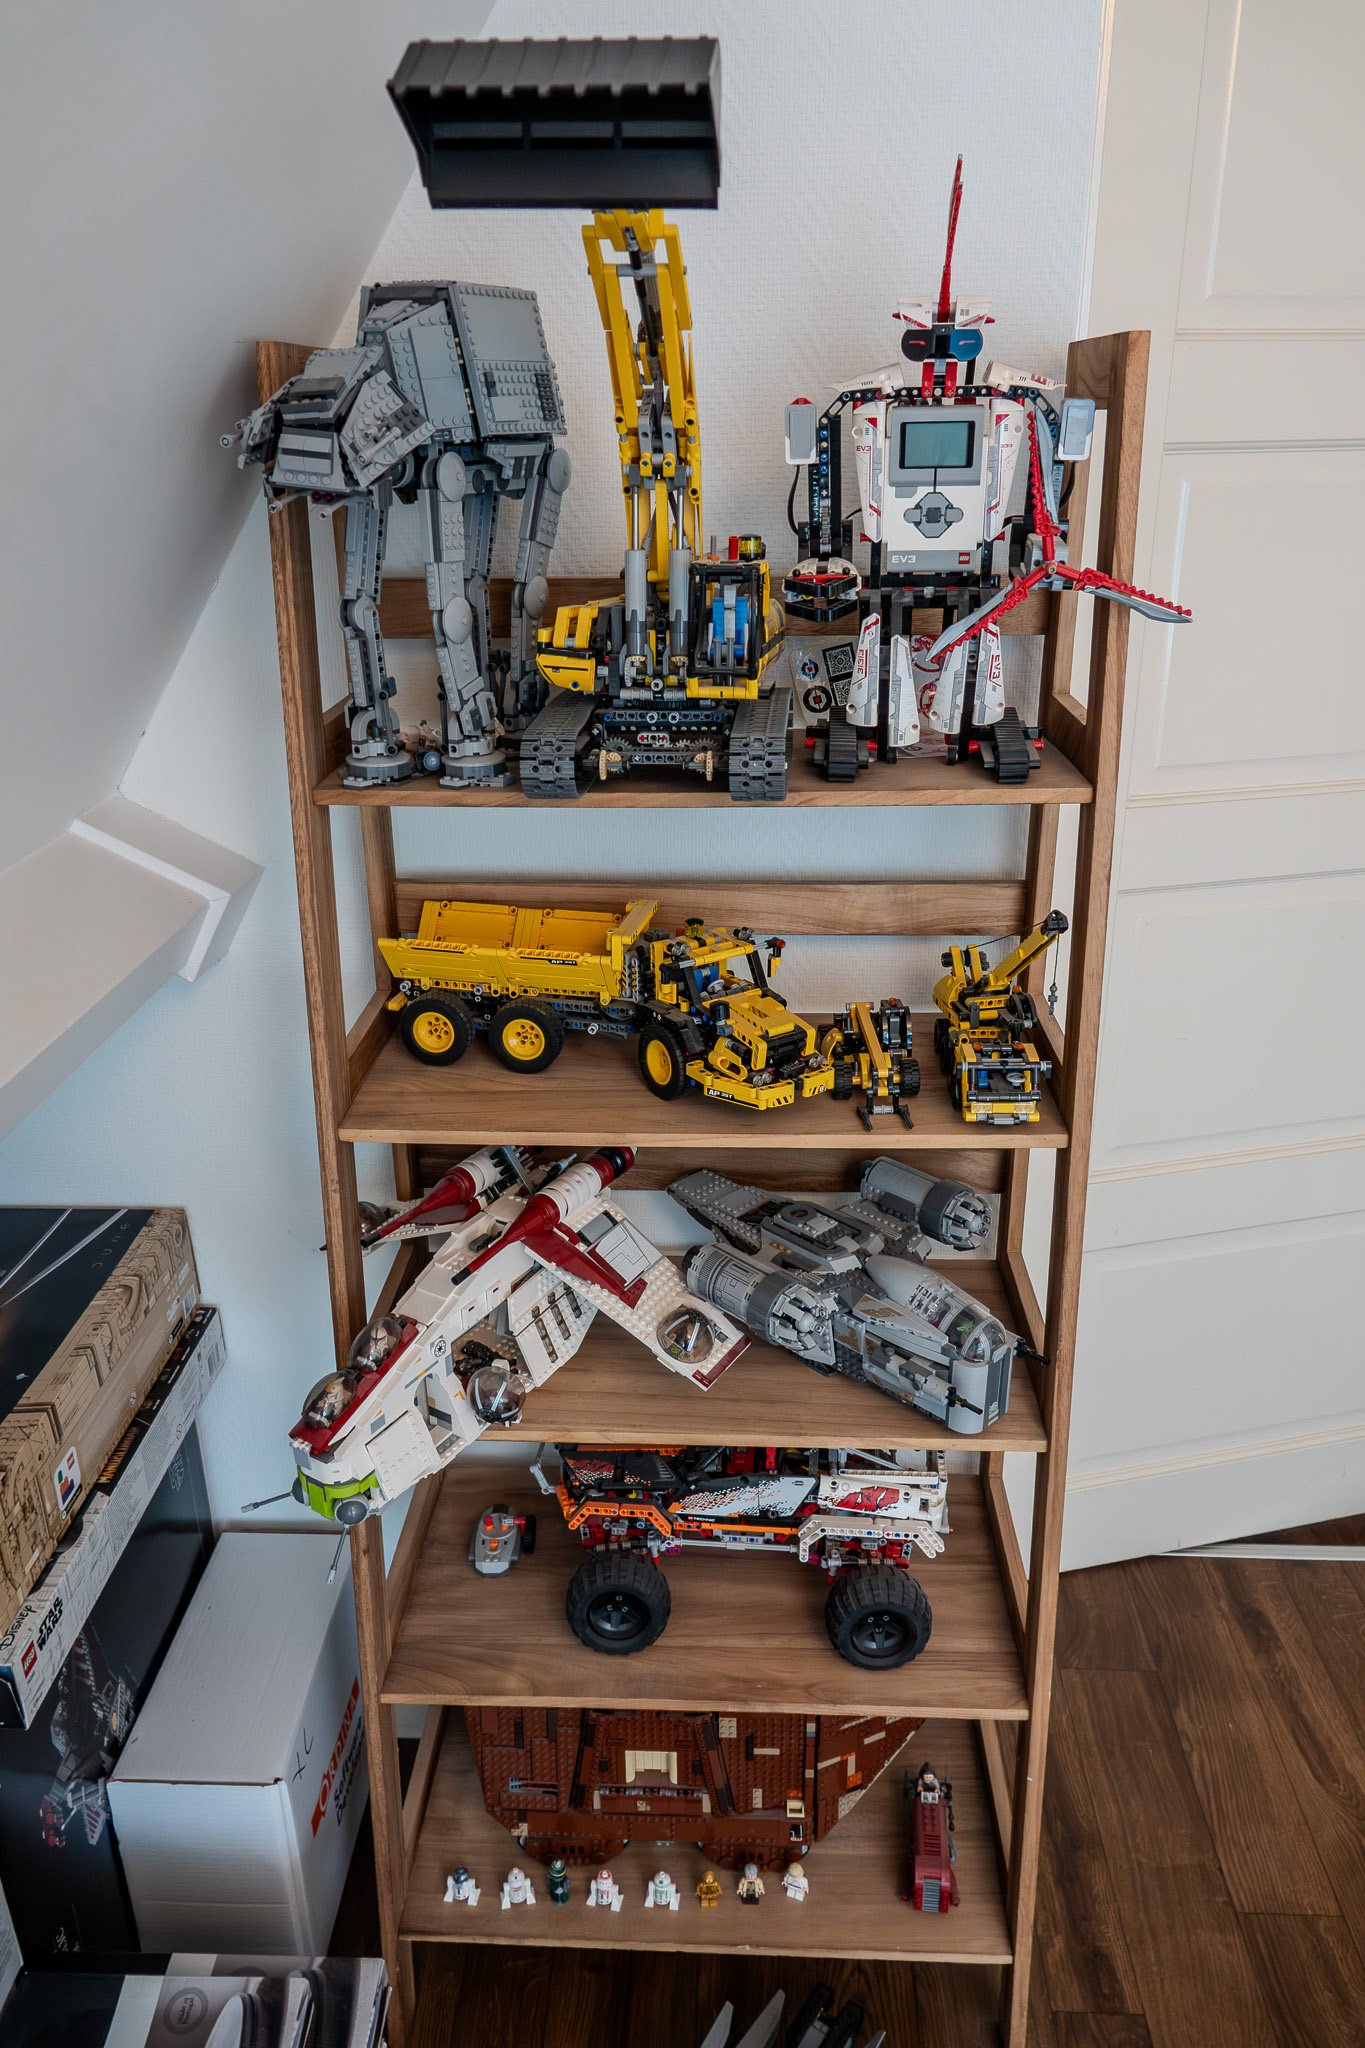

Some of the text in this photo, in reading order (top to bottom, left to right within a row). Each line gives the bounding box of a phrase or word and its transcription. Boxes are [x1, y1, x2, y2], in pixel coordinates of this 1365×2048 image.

[891, 555, 916, 564] EV3
[992, 654, 1001, 680] EV3
[37, 1606, 63, 1652] WARS
[39, 1596, 63, 1635] STAR
[334, 1716, 362, 1809] Software
